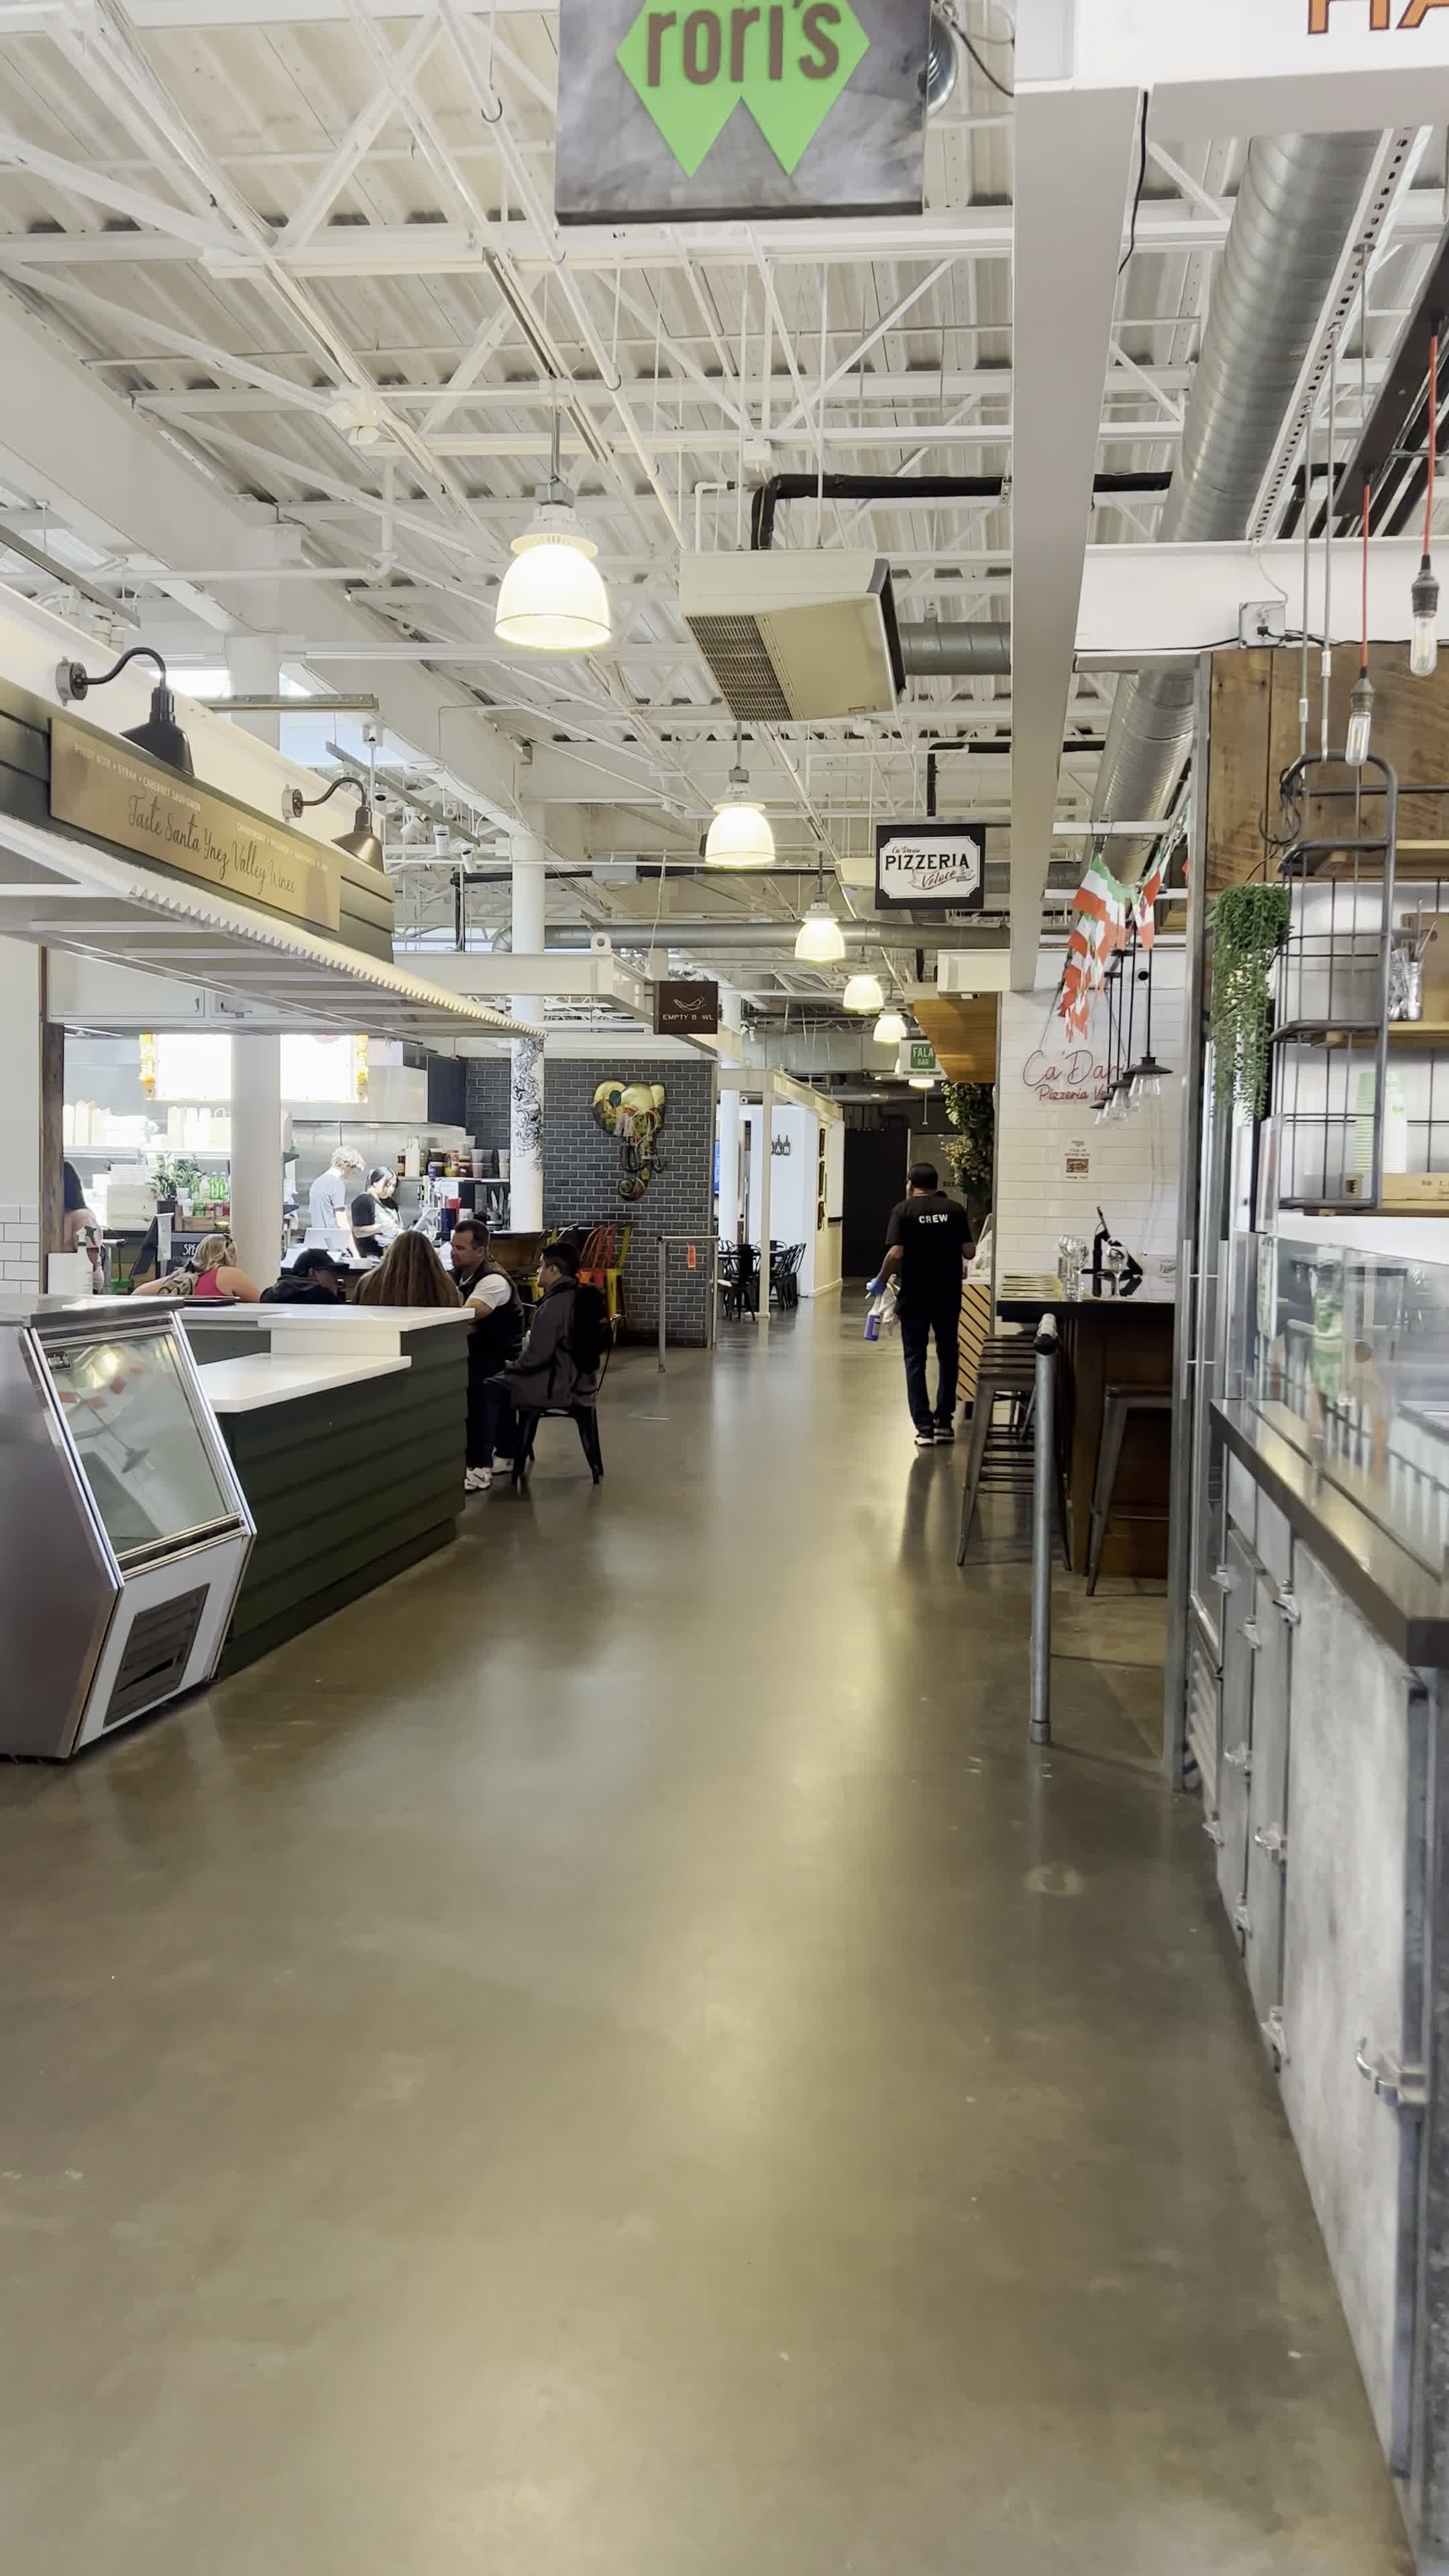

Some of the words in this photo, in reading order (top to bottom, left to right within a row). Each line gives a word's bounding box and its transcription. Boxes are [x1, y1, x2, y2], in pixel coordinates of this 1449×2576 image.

[128, 789, 161, 835] Taste
[163, 812, 201, 853] Santa
[203, 828, 229, 880] Ynez
[232, 840, 267, 896] Valley
[269, 859, 296, 893] Wines
[885, 853, 969, 871] PIZZERIA
[922, 870, 956, 888] Veloce
[913, 1046, 934, 1058] FALA
[1035, 1084, 1089, 1102] Pizzeria
[918, 1214, 948, 1224] CREW
